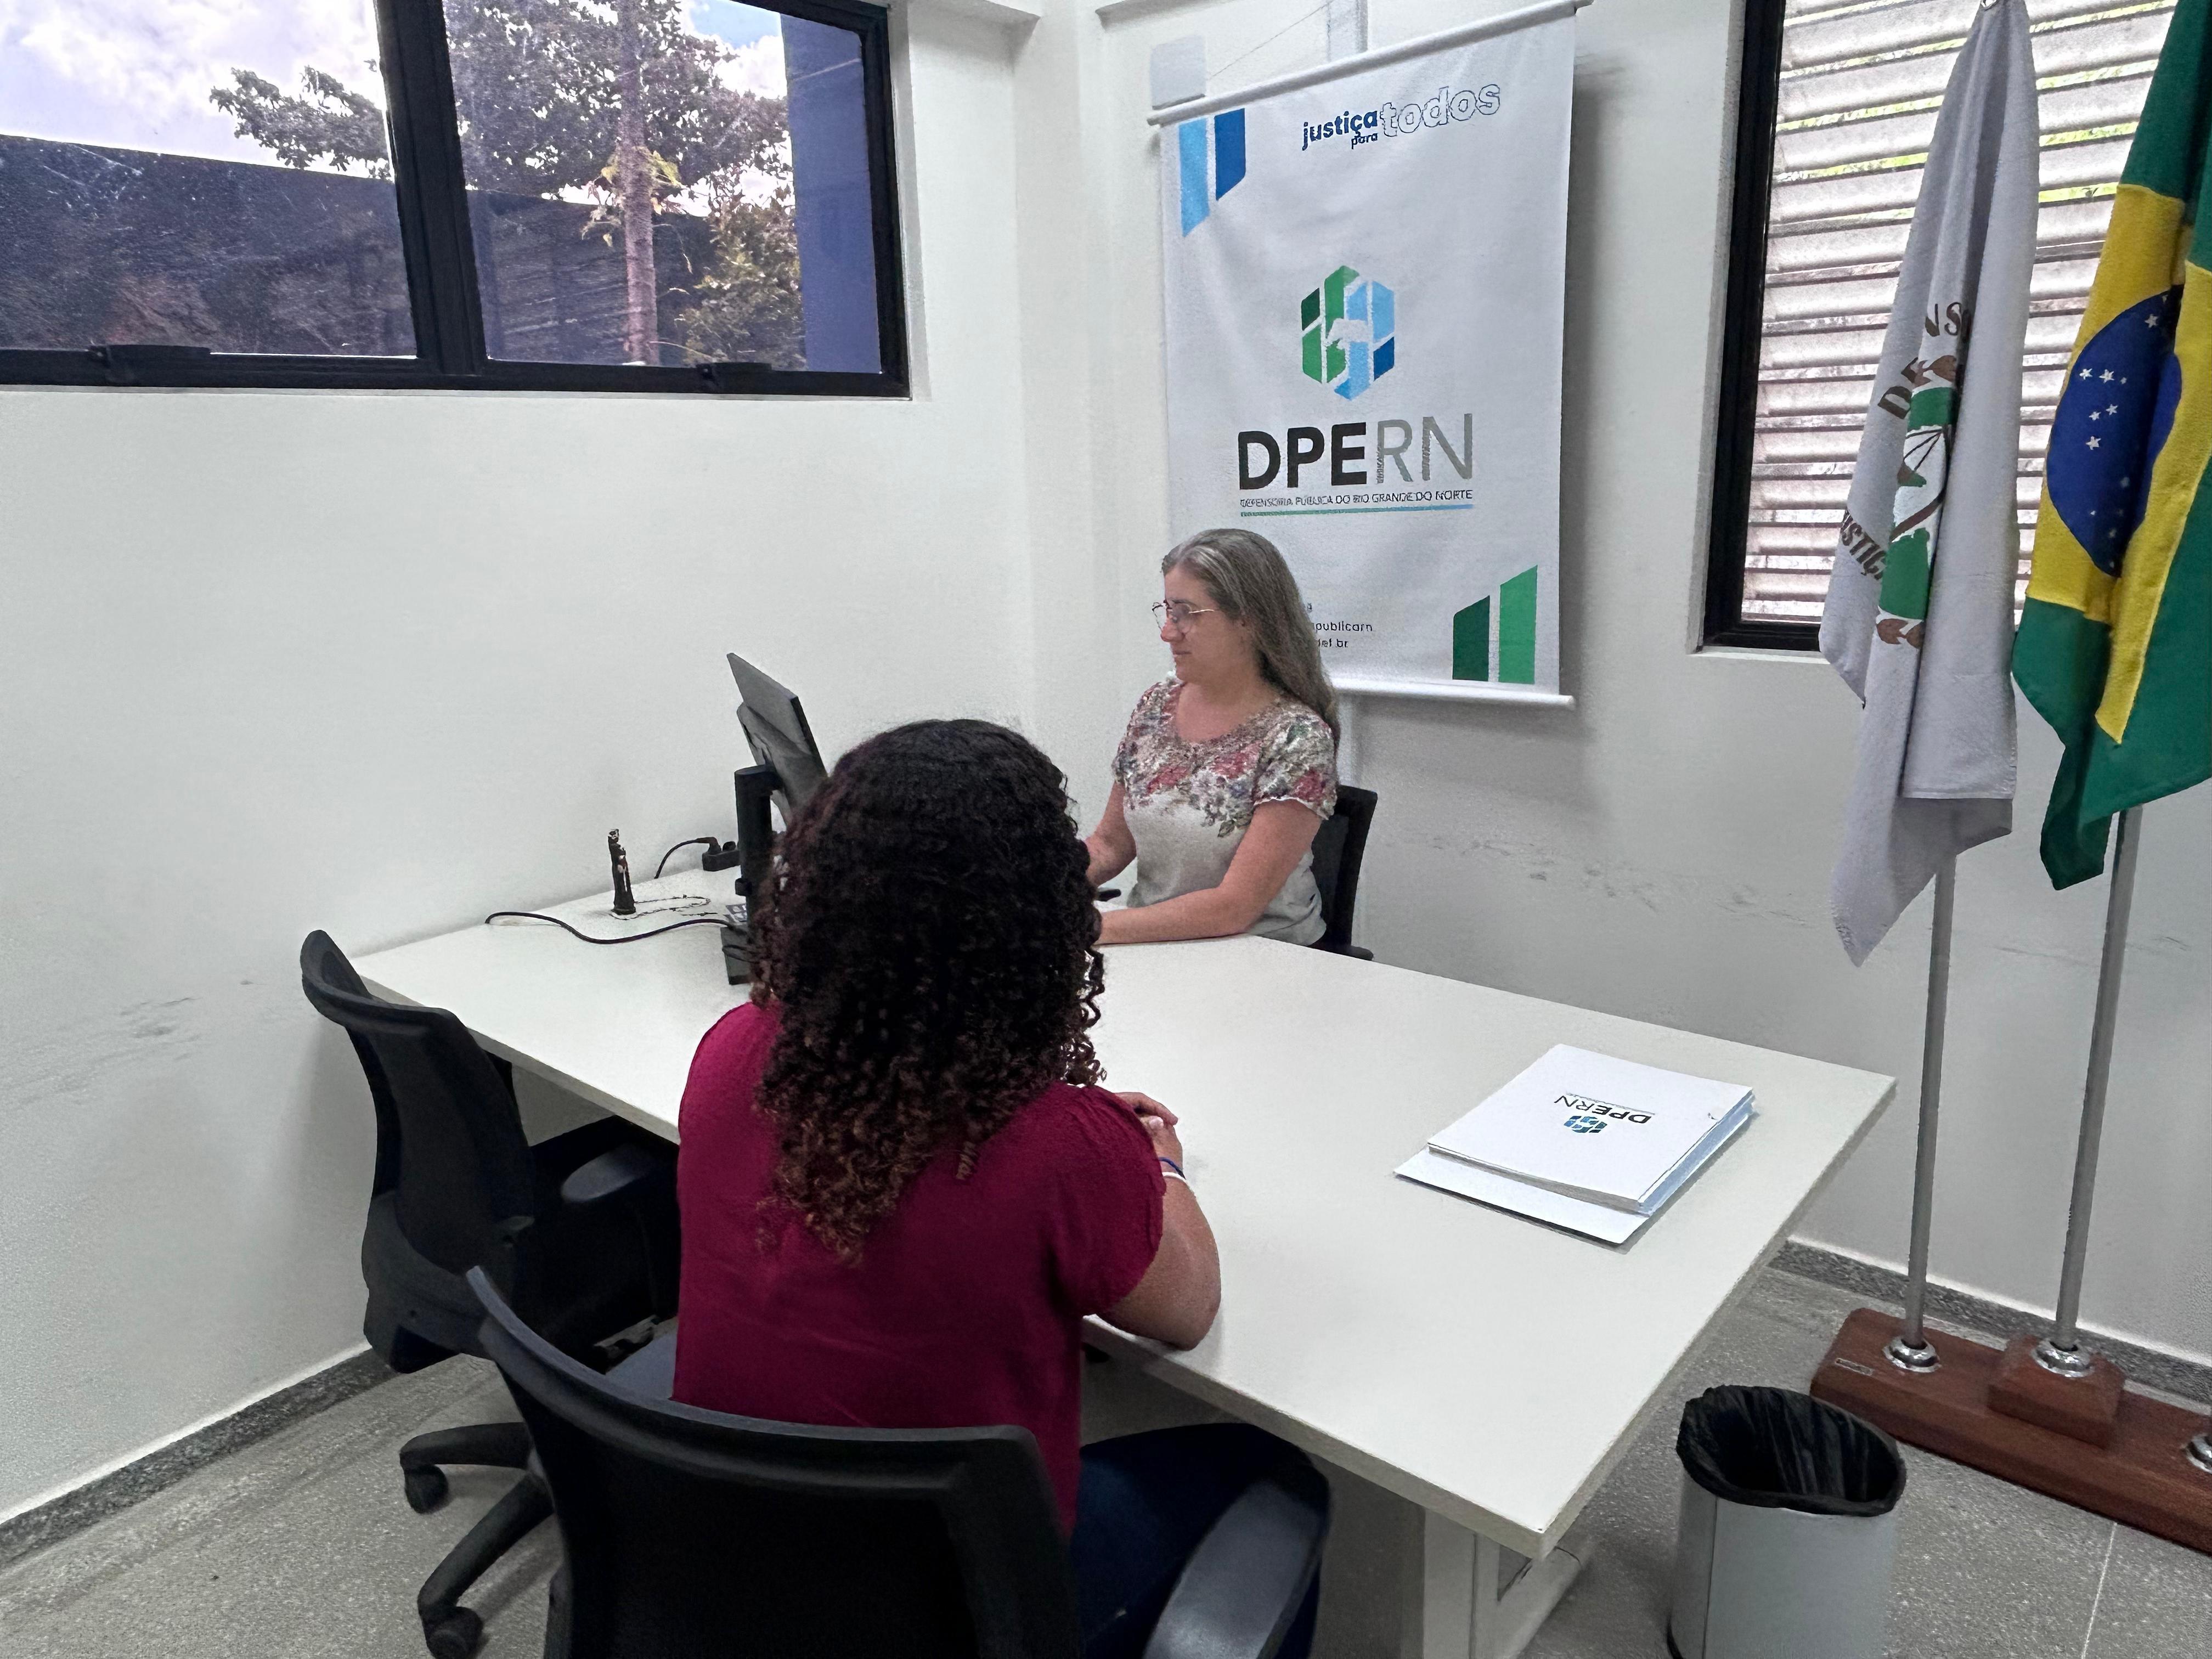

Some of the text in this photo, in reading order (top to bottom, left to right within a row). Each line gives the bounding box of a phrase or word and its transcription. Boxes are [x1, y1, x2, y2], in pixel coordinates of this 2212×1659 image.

[1302, 84, 1500, 151] justiça para todos
[1237, 413, 1474, 490] DPERN
[1335, 495, 1350, 504] DO
[1372, 493, 1413, 503] GRANDE
[1415, 492, 1432, 501] DO
[1435, 490, 1474, 500] NORTE
[1554, 1095, 1652, 1124] DPERN
